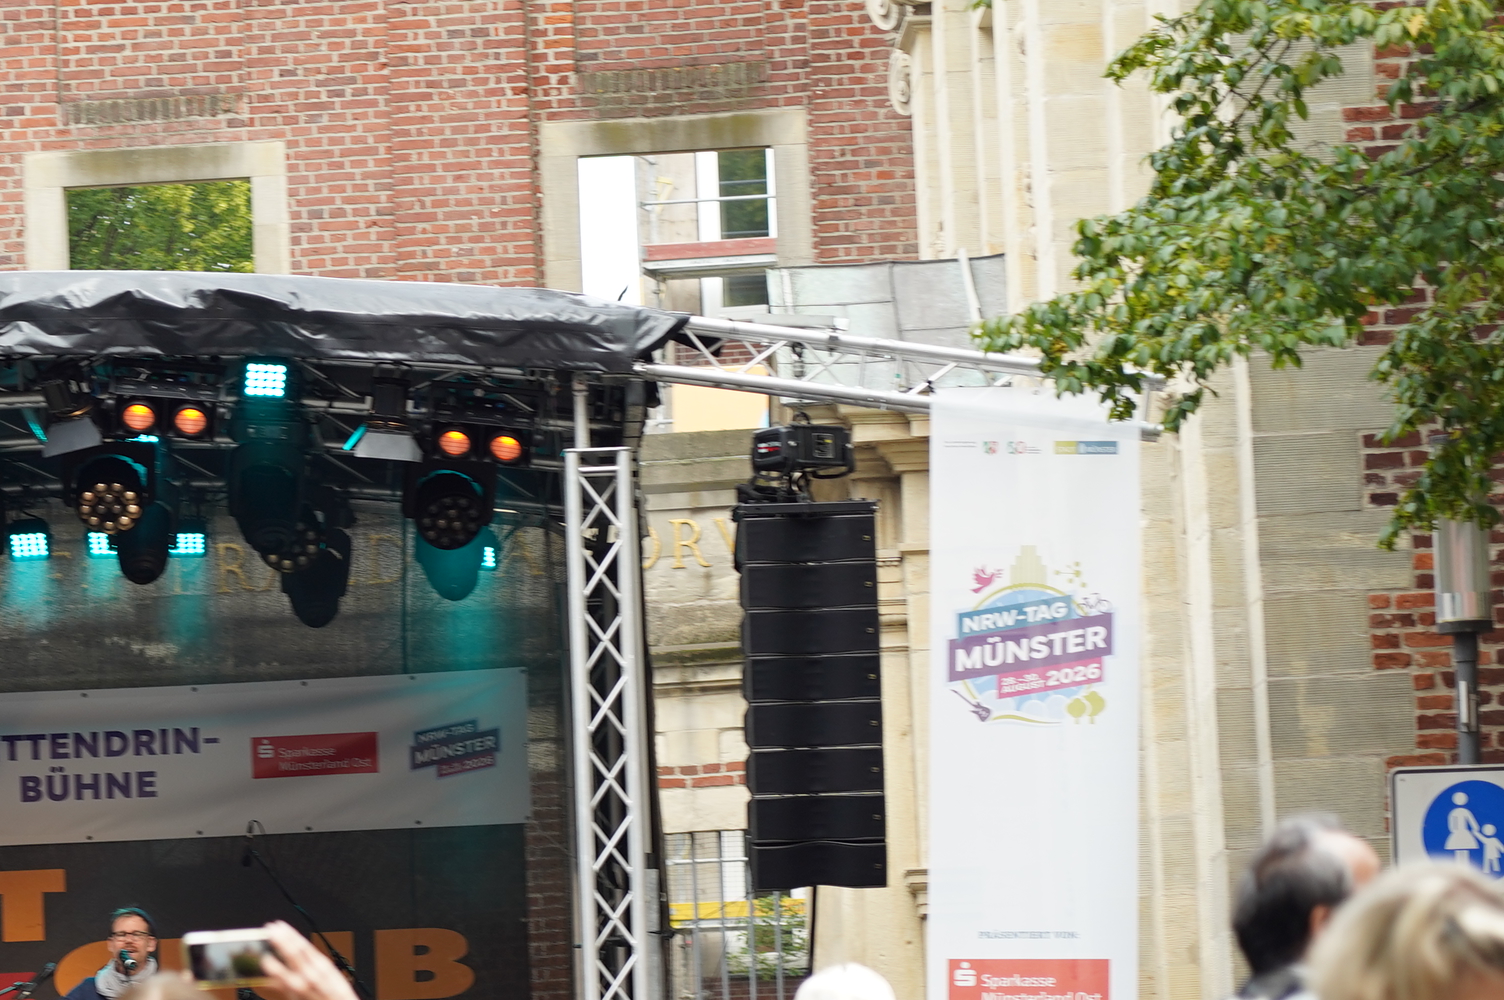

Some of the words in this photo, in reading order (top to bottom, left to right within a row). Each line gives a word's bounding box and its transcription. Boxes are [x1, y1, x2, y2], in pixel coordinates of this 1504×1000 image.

[962, 602, 1069, 633] NRW-TAG
[955, 626, 1108, 672] MÜNSTER
[1045, 663, 1102, 686] 2026
[278, 746, 337, 759] Sparkasse
[351, 757, 373, 768] Ost
[414, 736, 496, 764] MÜNSTER
[20, 766, 158, 803] BÜHNE
[980, 974, 1057, 989] Sparkasse
